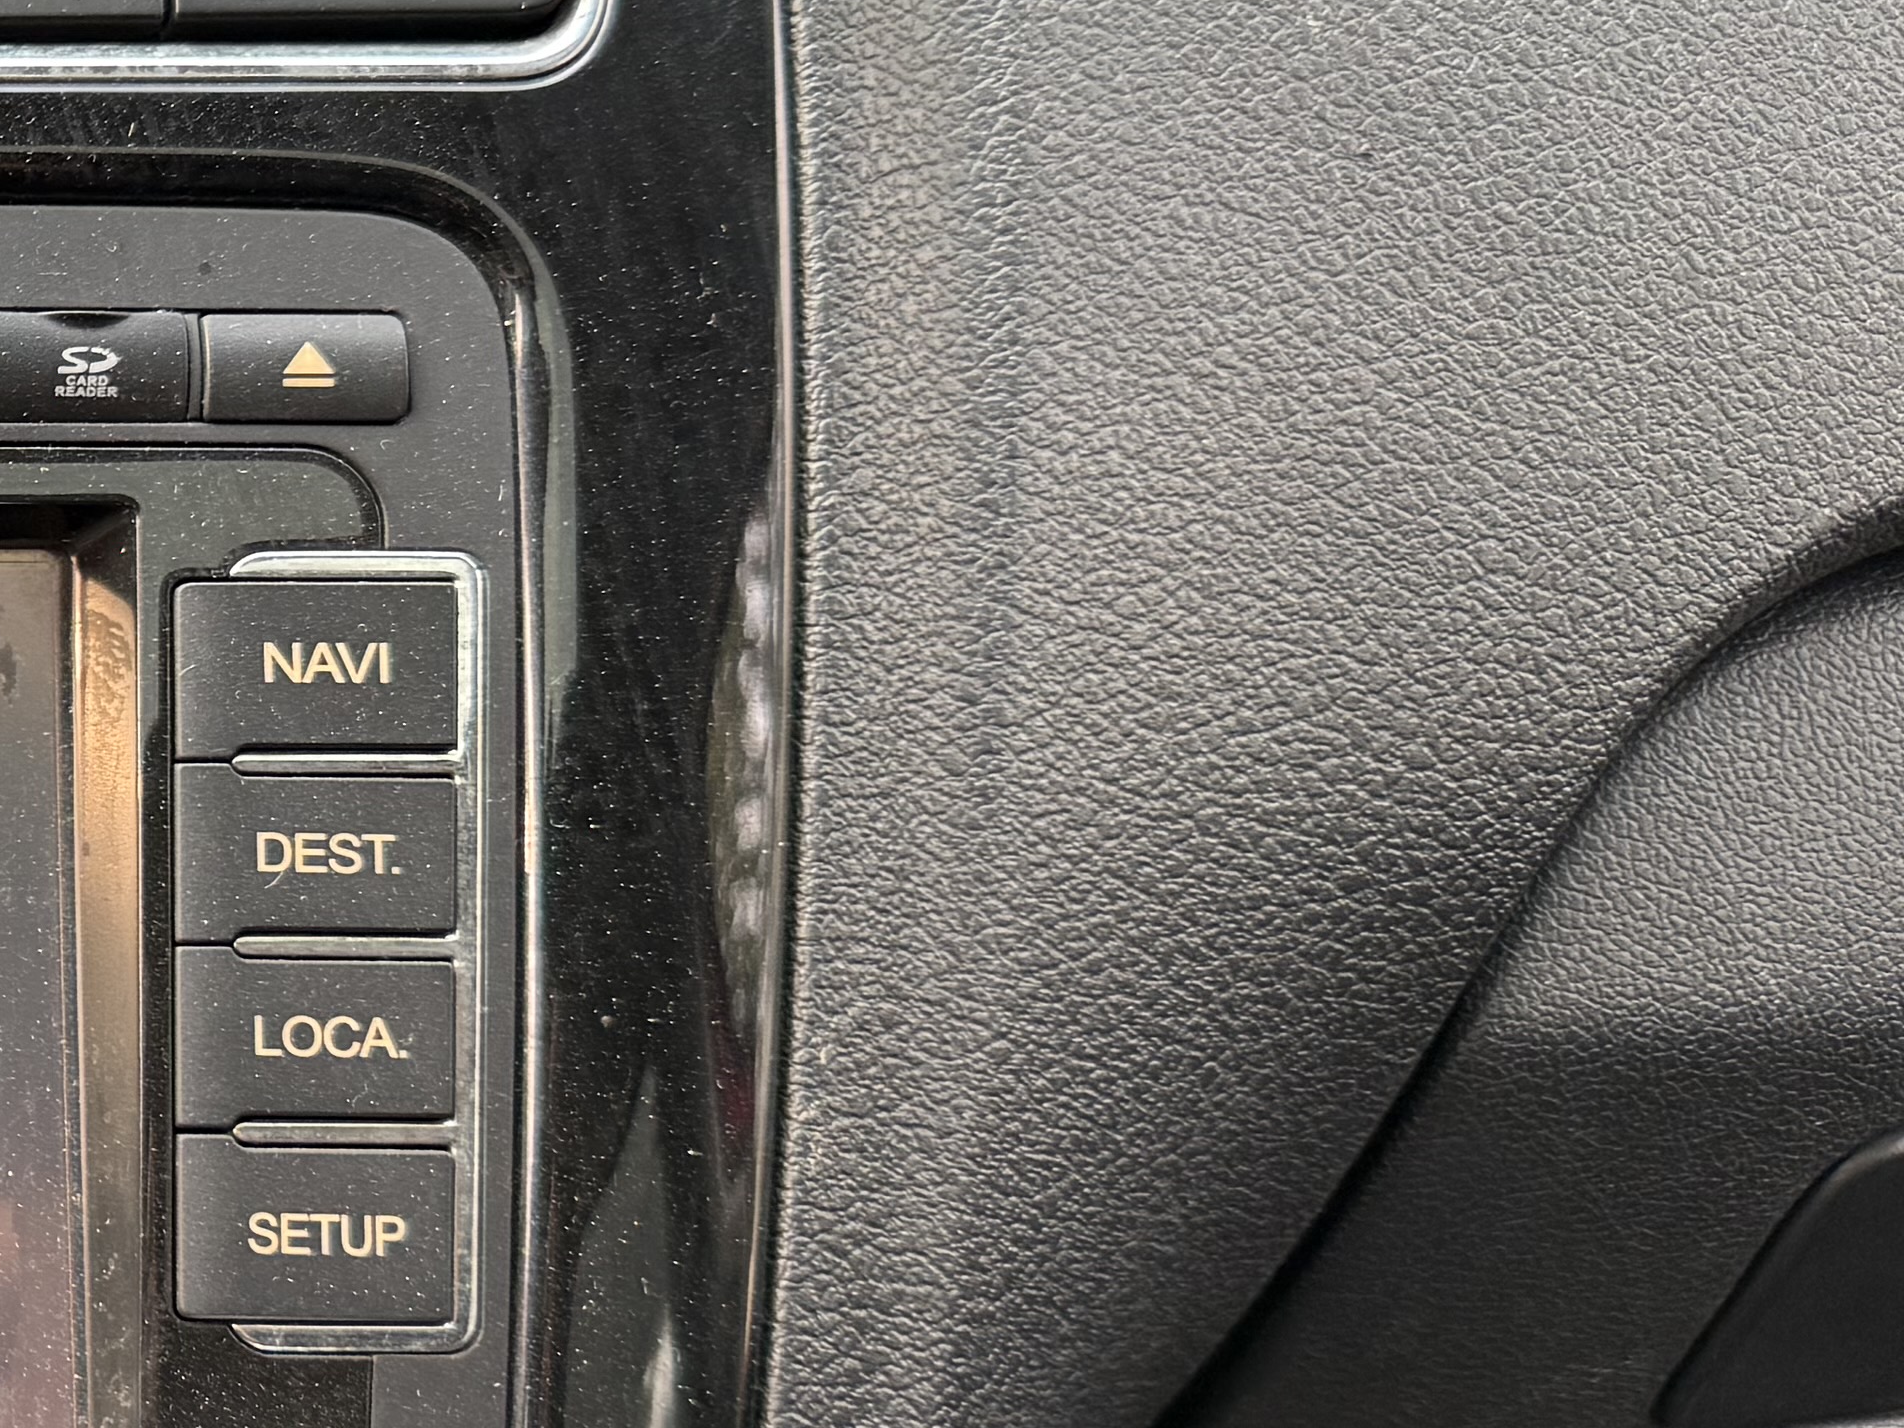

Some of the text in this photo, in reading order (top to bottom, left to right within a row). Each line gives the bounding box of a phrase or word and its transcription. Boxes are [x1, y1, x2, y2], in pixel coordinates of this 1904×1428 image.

[54, 386, 119, 398] READER
[66, 375, 108, 386] CARD
[264, 642, 391, 683] NAVI
[256, 831, 400, 875] DEST.
[254, 1014, 408, 1059] LOCA.
[248, 1212, 407, 1257] SETUP
